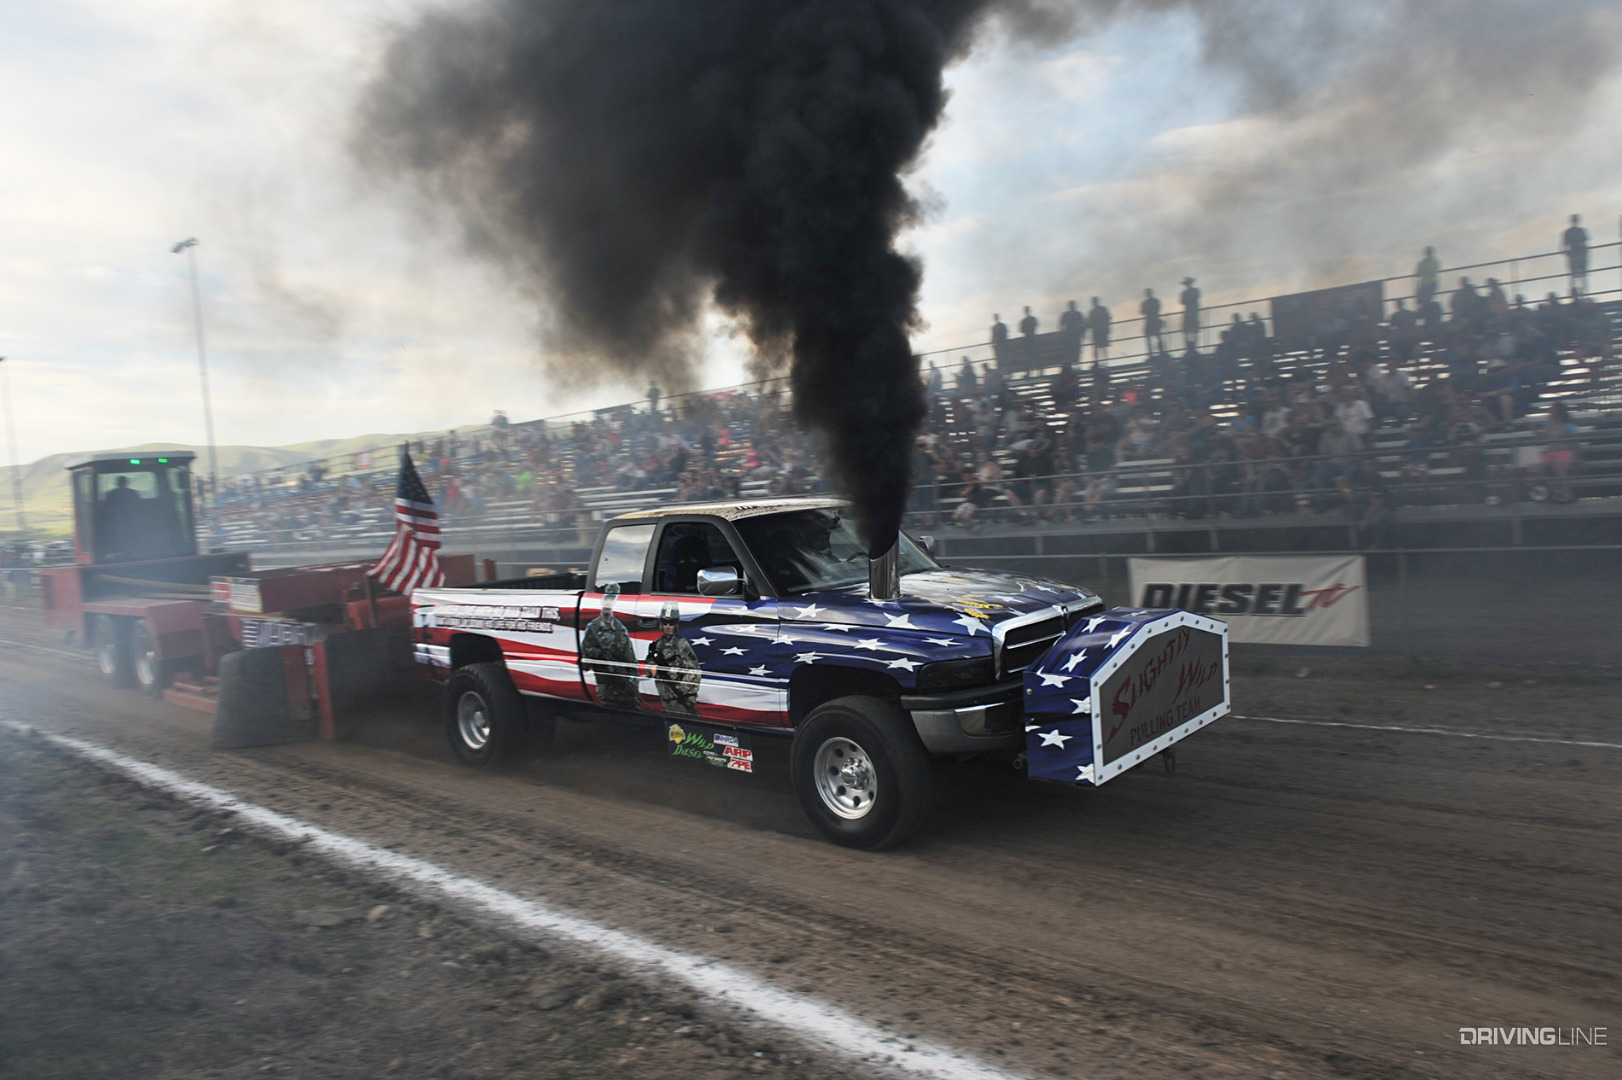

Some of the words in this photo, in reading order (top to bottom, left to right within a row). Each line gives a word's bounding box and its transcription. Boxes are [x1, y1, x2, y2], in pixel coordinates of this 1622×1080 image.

[1141, 583, 1306, 616] DIESEL
[1130, 709, 1174, 746] PULLING
[1176, 697, 1201, 719] TEAM
[724, 746, 752, 759] ARP
